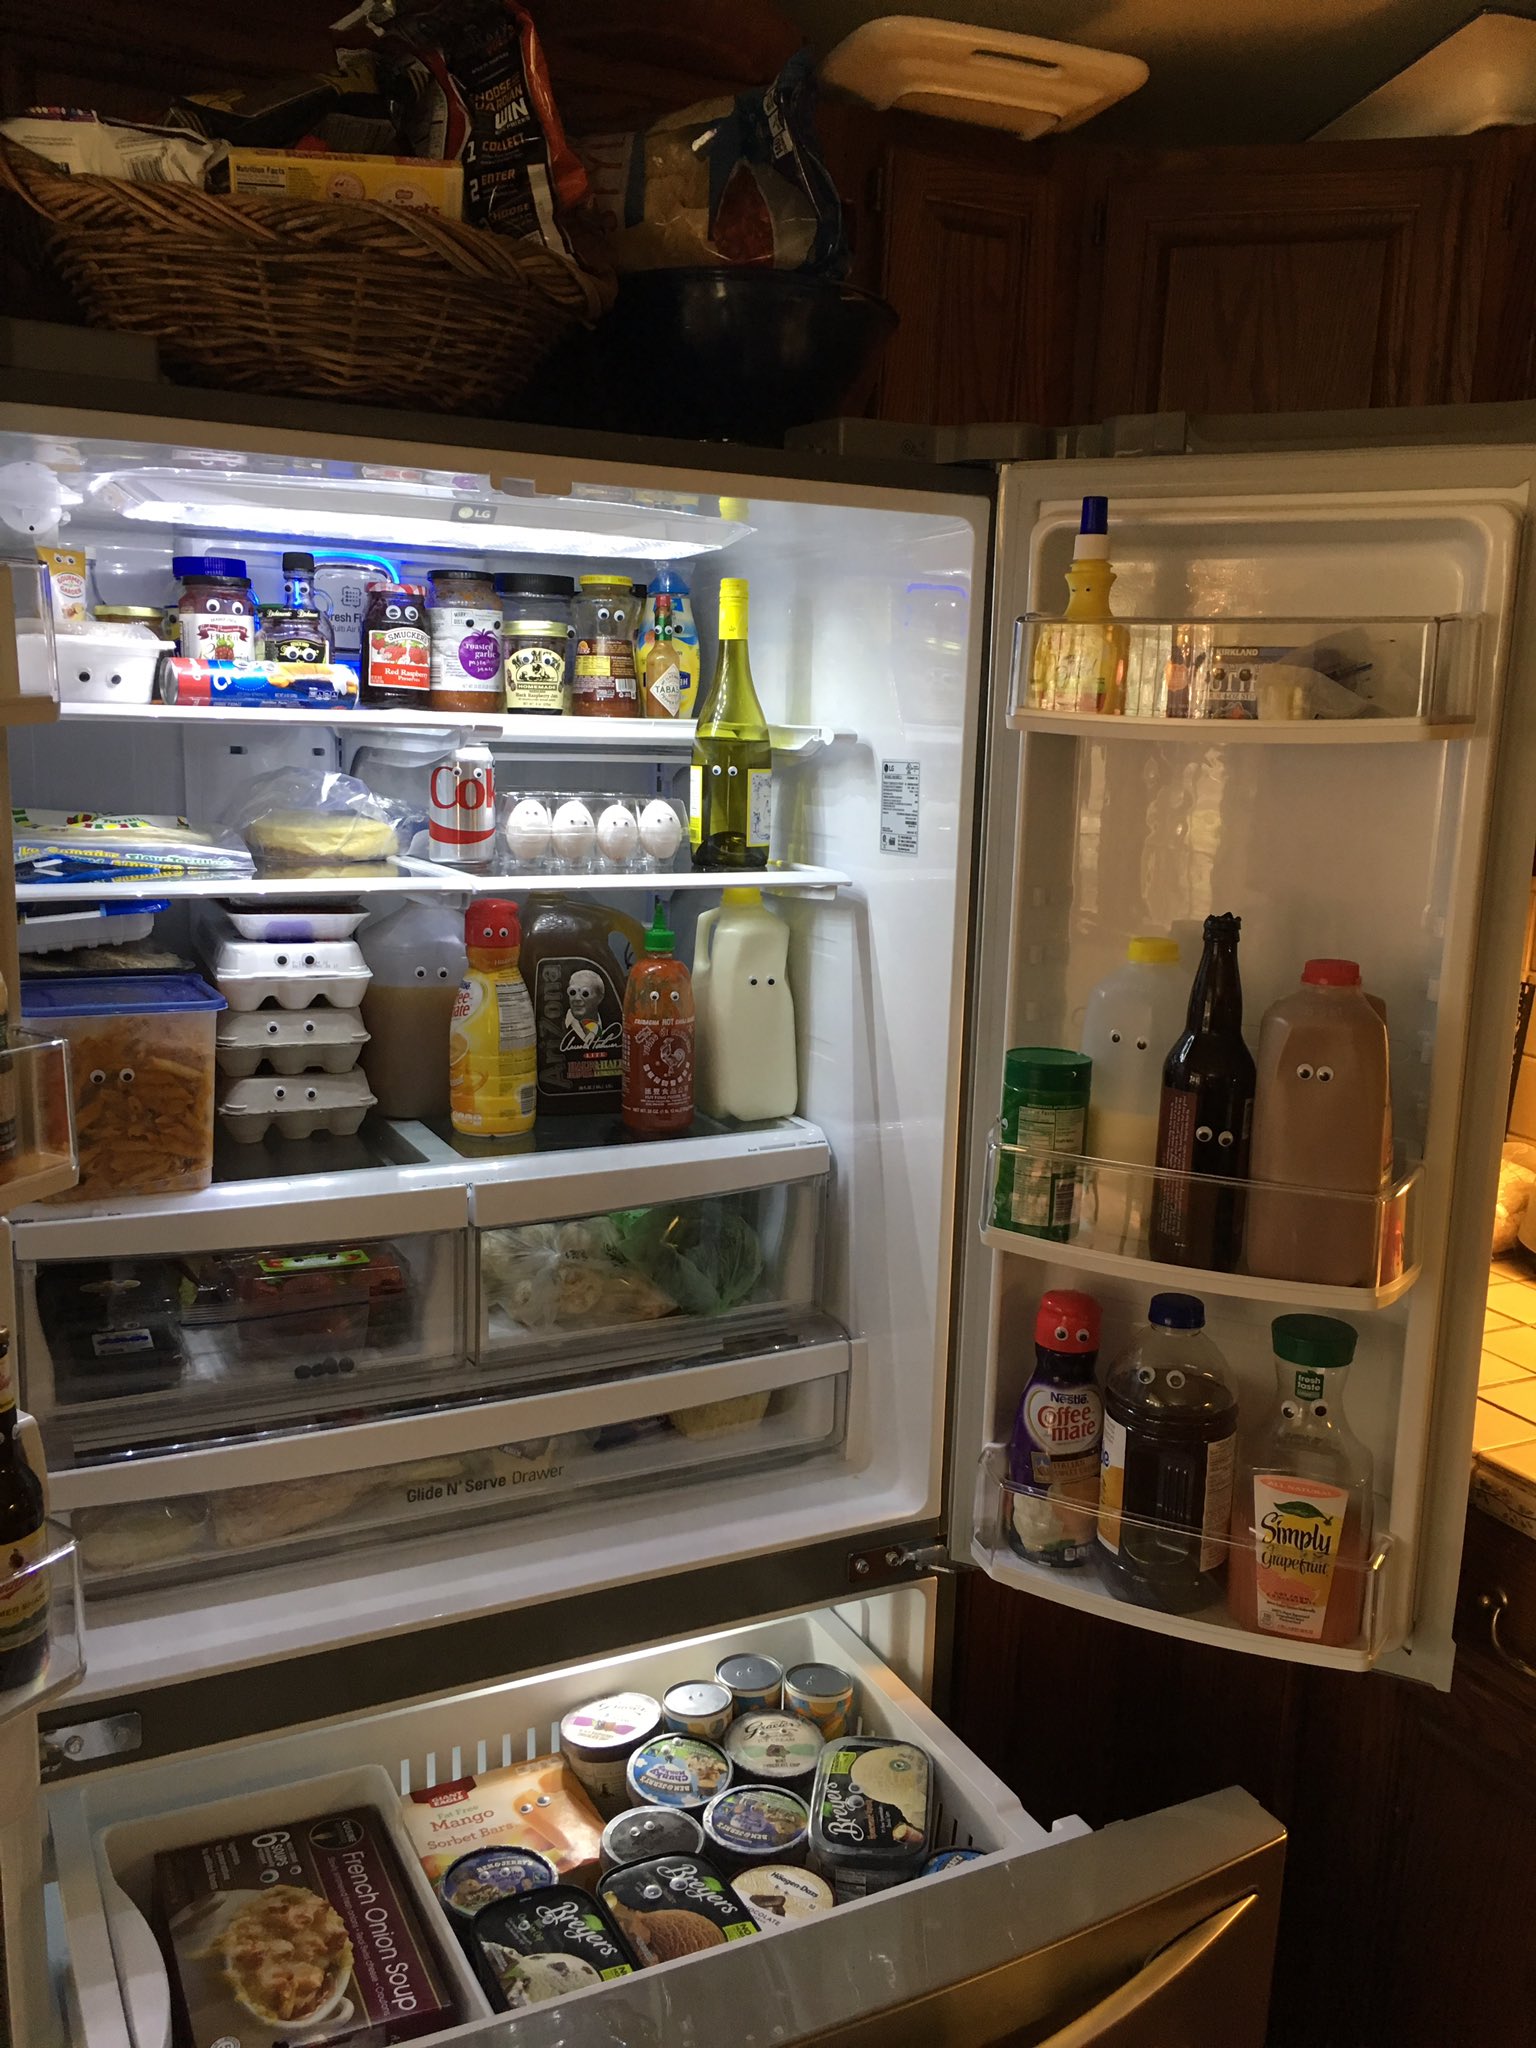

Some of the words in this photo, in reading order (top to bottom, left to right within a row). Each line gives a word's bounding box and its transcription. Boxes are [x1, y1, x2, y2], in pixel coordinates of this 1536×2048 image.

[495, 97, 529, 130] WIN
[482, 132, 525, 152] COLLECT
[481, 168, 516, 186] ENTER
[475, 510, 490, 519] LG
[465, 643, 494, 651] roasted
[474, 650, 497, 659] garlic
[1216, 648, 1259, 656] KIRKLAND
[401, 668, 428, 680] Raspberry
[430, 766, 495, 810] Cok
[662, 1018, 675, 1026] HOT
[1297, 1381, 1321, 1391] taste
[1298, 1374, 1321, 1384] fresh
[1052, 1420, 1096, 1441] mate
[407, 1488, 443, 1503] Glide
[465, 1476, 506, 1493] Serve
[512, 1465, 565, 1485] Drawer
[1267, 1480, 1284, 1488] ALL
[1287, 1483, 1333, 1496] NATURAL
[1260, 1511, 1332, 1556] Simply
[1261, 1551, 1329, 1576] Grapefruit
[650, 1768, 689, 1782] Chunky
[430, 1810, 495, 1832] Mango
[437, 1810, 454, 1820] Fat
[455, 1805, 479, 1815] Free
[823, 1782, 865, 1842] Breyers
[251, 1831, 291, 1847] 6
[427, 1832, 478, 1850] Sorbet
[478, 1822, 515, 1838] Bars
[272, 1843, 289, 1868] SOUPS
[656, 1863, 739, 1916] Breyers
[770, 1871, 820, 1898] Häagen-Dazs
[747, 1906, 781, 1927] OCOLATE
[342, 1850, 380, 1905] French
[364, 1907, 398, 1960] Onion
[385, 1962, 418, 2011] Soup
[535, 1901, 618, 1956] Breyers
[366, 1960, 379, 1982] cheese
[375, 1986, 392, 2017] Croutons
